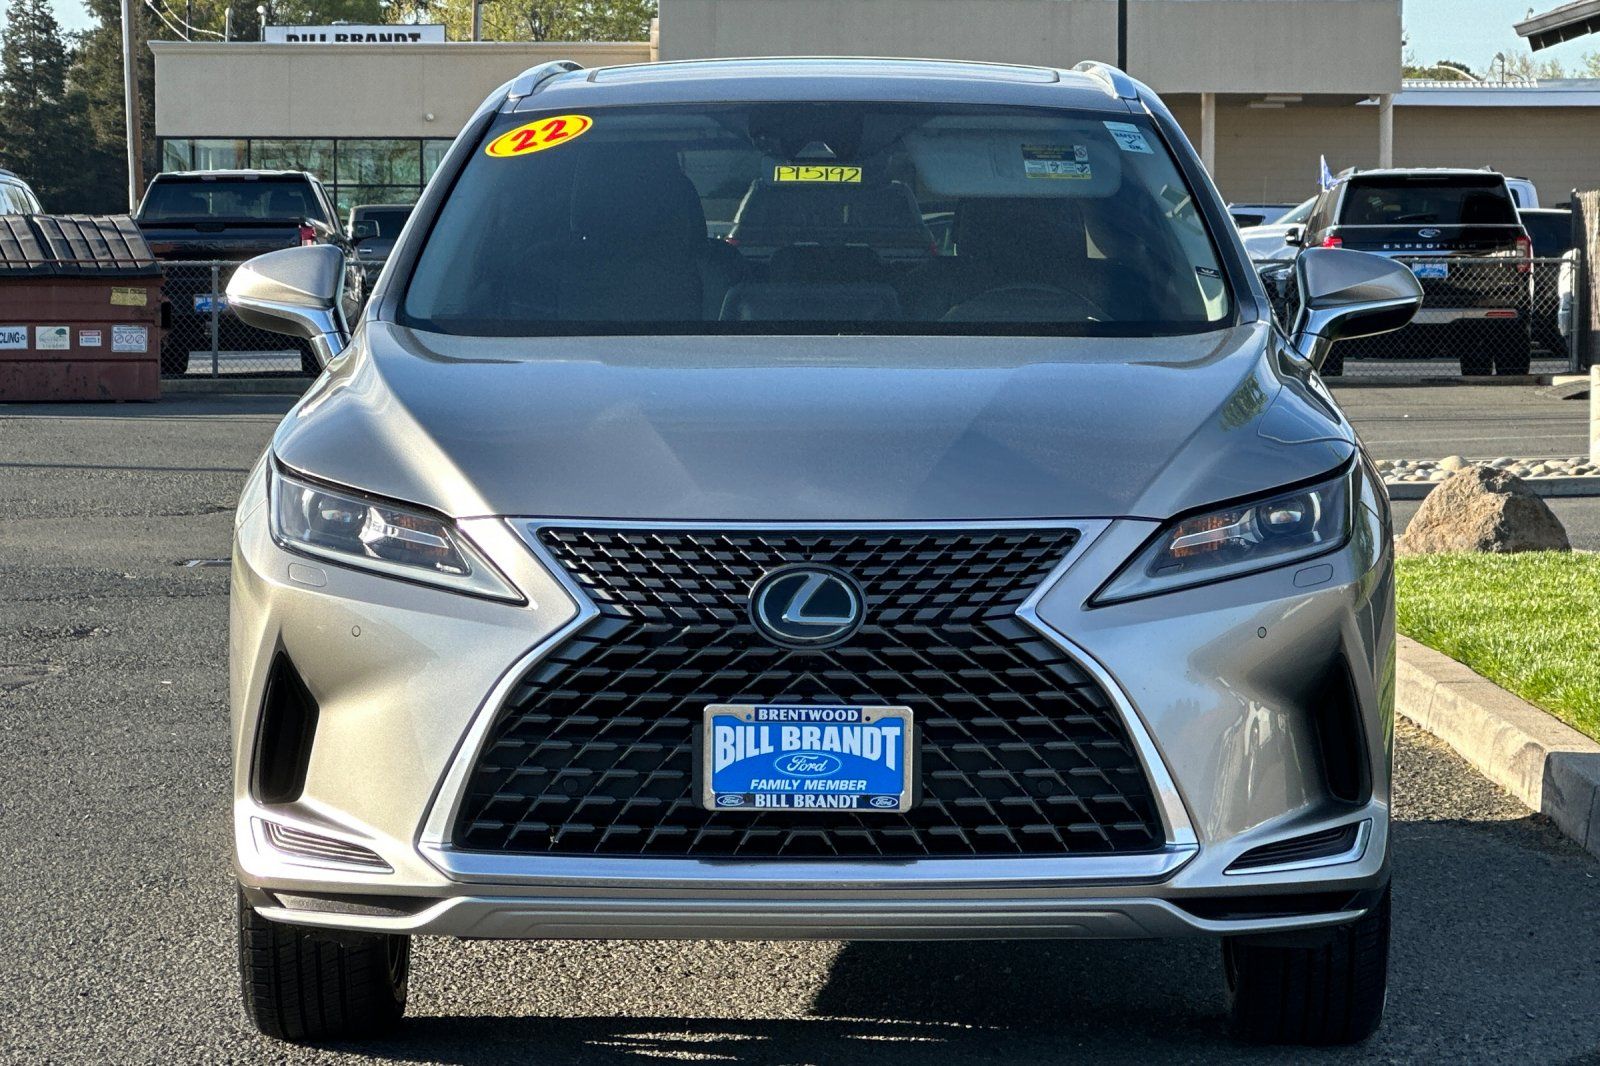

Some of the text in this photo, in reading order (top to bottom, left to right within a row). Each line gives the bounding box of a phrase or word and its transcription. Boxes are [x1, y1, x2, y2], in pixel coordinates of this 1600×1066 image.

[510, 119, 569, 153] 22
[777, 166, 860, 182] P15192
[758, 708, 859, 722] BRENTWOOD
[715, 725, 901, 774] BILL BRANDT
[786, 754, 828, 773] Ford
[750, 778, 868, 791] FAMILY MEMBER
[754, 794, 860, 809] BILL BRANDT
